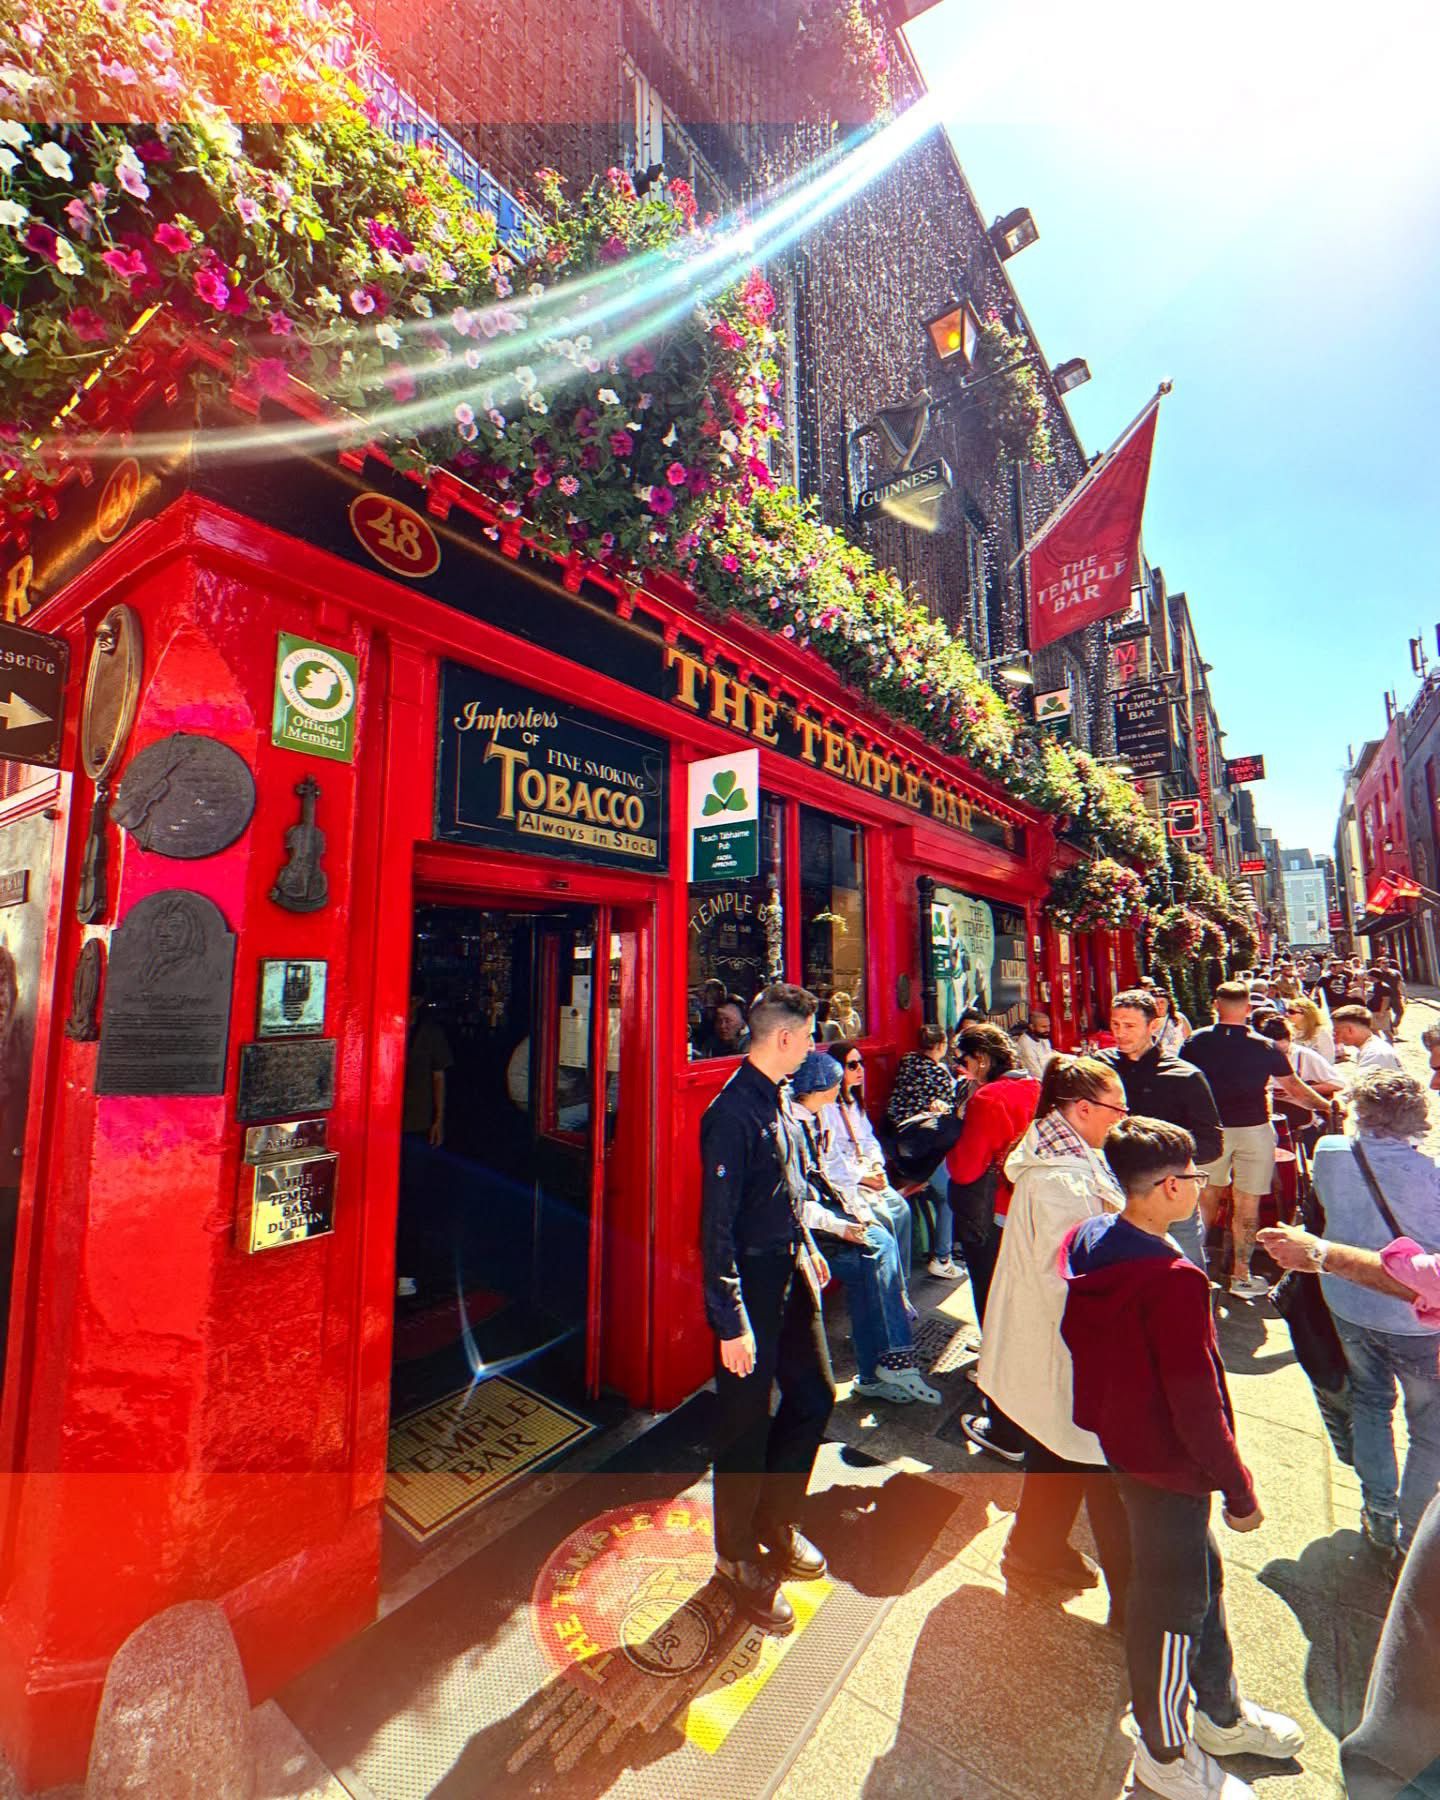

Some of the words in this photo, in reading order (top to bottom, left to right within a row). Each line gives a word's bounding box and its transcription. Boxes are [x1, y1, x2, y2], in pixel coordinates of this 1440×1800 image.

[860, 466, 939, 508] GUINNESS
[368, 507, 422, 561] 48
[1036, 558, 1129, 606] TEMPLE
[1060, 553, 1098, 575] THE
[1053, 583, 1101, 614] BAR
[454, 701, 559, 742] Importers
[1116, 697, 1167, 712] TEMPLE
[1128, 709, 1155, 720] BAR
[288, 726, 343, 749] Member
[292, 715, 339, 736] Official
[522, 731, 540, 747] OF
[664, 647, 781, 746] THE
[794, 713, 922, 809] TEMPLE
[931, 786, 974, 833] BAR
[484, 742, 645, 831] TOBACCO
[547, 749, 582, 774] FINE
[584, 758, 645, 791] SMOKING
[520, 809, 585, 842] Always
[592, 829, 608, 846] in
[613, 832, 657, 857] Stock
[718, 842, 731, 850] Pub
[688, 892, 753, 933] TEMPLE
[269, 1184, 325, 1206] TEMPLE
[284, 1173, 313, 1187] THE
[268, 1212, 324, 1233] DUBLIN
[283, 1200, 312, 1217] BAR
[388, 1397, 541, 1488] TEMPLE
[407, 1402, 482, 1443] THE
[448, 1432, 537, 1486] BAR
[666, 1510, 713, 1536] BA
[551, 1514, 655, 1608] TEMPLE
[554, 1613, 616, 1685] THE
